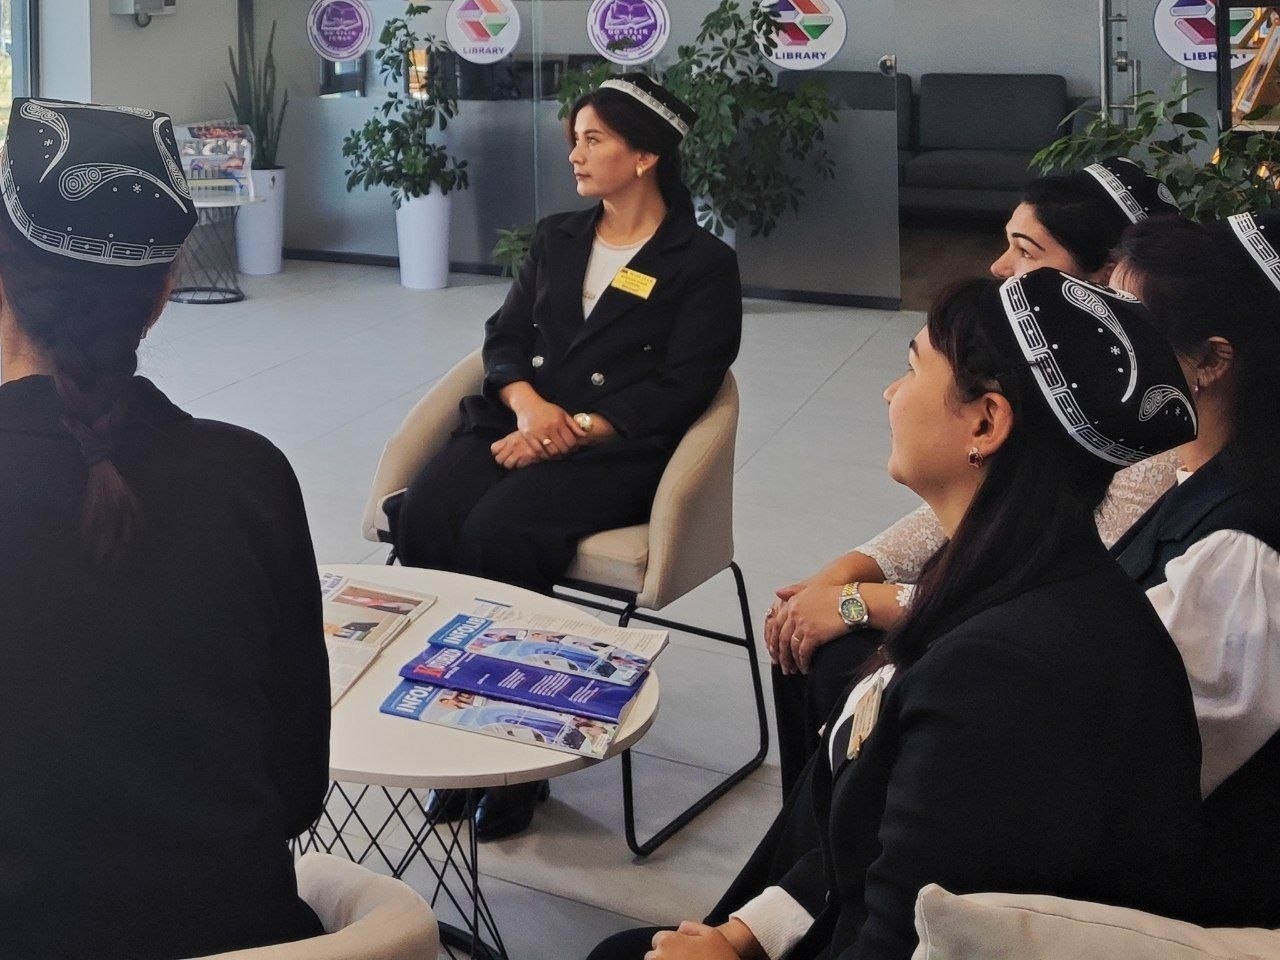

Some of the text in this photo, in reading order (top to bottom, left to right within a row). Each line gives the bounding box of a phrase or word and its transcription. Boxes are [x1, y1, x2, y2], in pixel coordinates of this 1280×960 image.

[462, 46, 505, 55] LIBRARY
[775, 51, 827, 60] LIBRARY
[1183, 50, 1248, 61] LIBR
[442, 616, 487, 645] INFOLIB
[395, 684, 434, 713] INFOL
